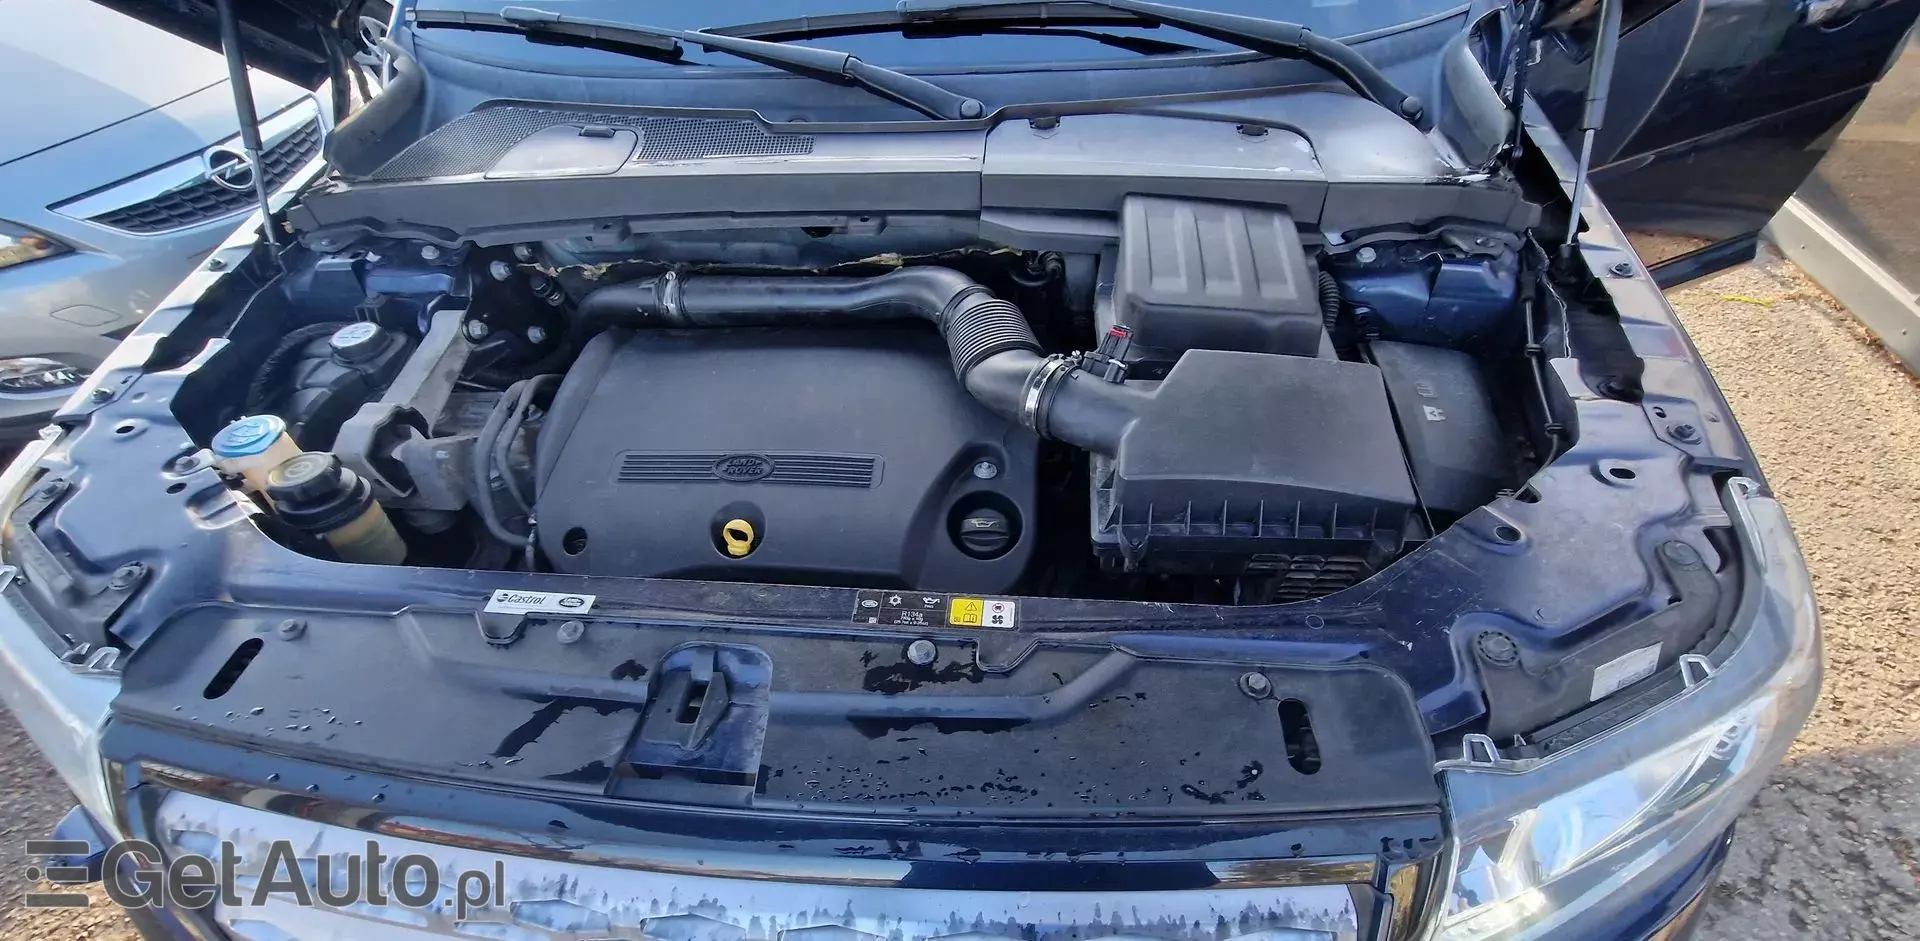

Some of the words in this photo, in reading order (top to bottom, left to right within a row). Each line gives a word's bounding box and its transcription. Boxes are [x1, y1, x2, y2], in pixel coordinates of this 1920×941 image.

[726, 465, 762, 474] ROVER
[508, 594, 547, 605] Castrol
[901, 610, 923, 618] R134a
